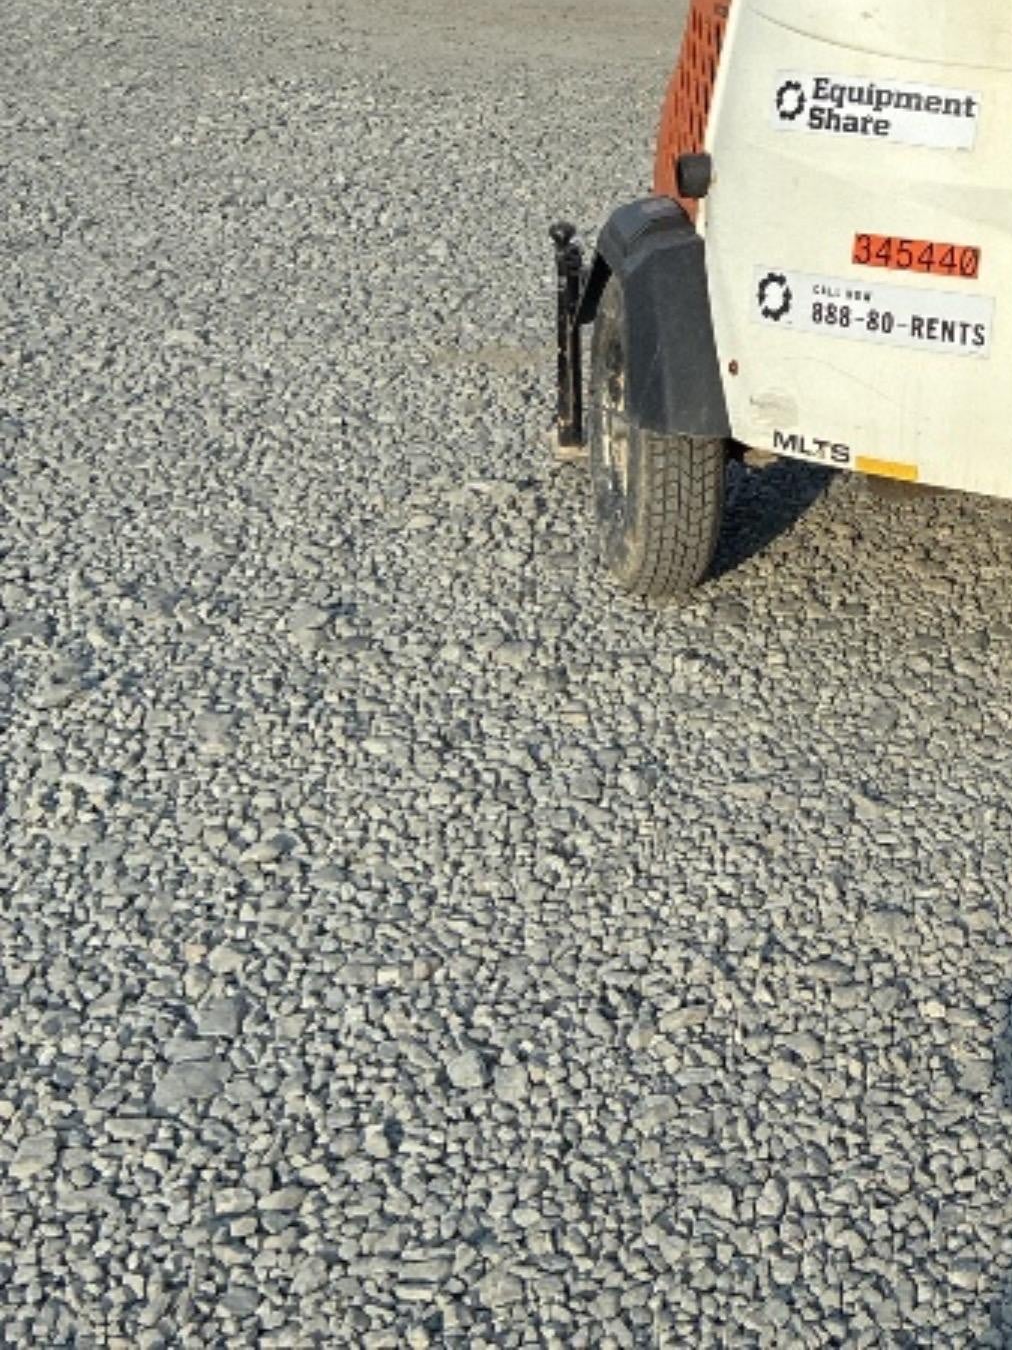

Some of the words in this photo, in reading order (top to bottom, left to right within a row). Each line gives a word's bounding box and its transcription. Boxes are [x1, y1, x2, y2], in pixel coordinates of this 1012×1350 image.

[811, 77, 979, 118] Equipment
[807, 107, 892, 137] Share
[854, 233, 980, 277] 345440
[811, 301, 986, 347] 888-80-RENTS
